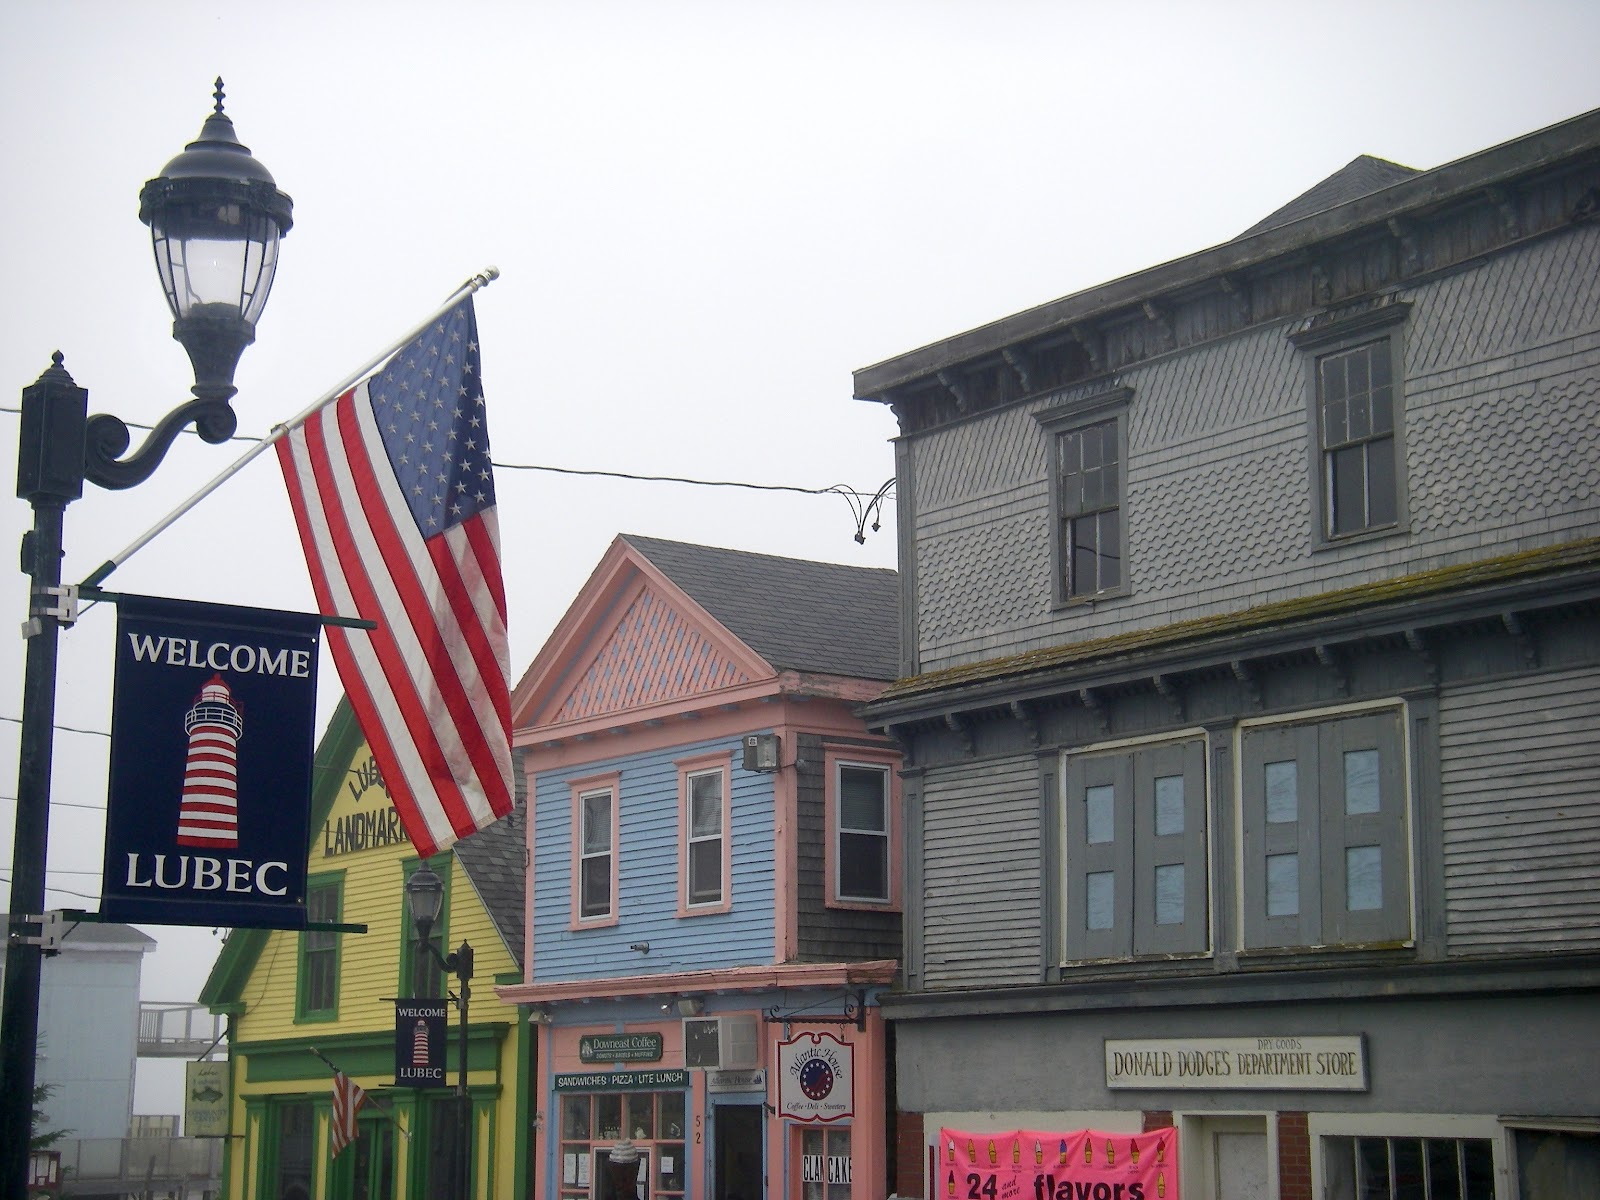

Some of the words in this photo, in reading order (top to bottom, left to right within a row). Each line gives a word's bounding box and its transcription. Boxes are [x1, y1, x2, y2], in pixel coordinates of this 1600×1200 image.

[127, 632, 310, 678] WELCOME
[348, 755, 391, 802] LUB
[126, 852, 289, 896] LUBEC
[398, 1007, 446, 1018] WELCOME
[593, 1038, 630, 1050] Downeast
[631, 1036, 657, 1048] Coffee
[1257, 1039, 1274, 1050] DRY
[1275, 1038, 1302, 1050] GOODS
[789, 1044, 822, 1080] Atlantic
[821, 1048, 843, 1079] House
[1113, 1051, 1172, 1077] DONALD
[1236, 1052, 1312, 1076] DEPARTMENT
[1316, 1051, 1358, 1076] STORE
[400, 1067, 442, 1079] LUBEC
[558, 1074, 607, 1088] SANDWICHES
[611, 1074, 634, 1085] PIZZA
[638, 1073, 654, 1084] LITE
[656, 1072, 683, 1083] LUNCH
[786, 1102, 803, 1111] Coffee
[806, 1102, 819, 1110] Deli
[966, 1173, 998, 1200] 24
[1001, 1175, 1017, 1191] and
[1034, 1173, 1146, 1200] flavors
[1001, 1186, 1020, 1199] more
